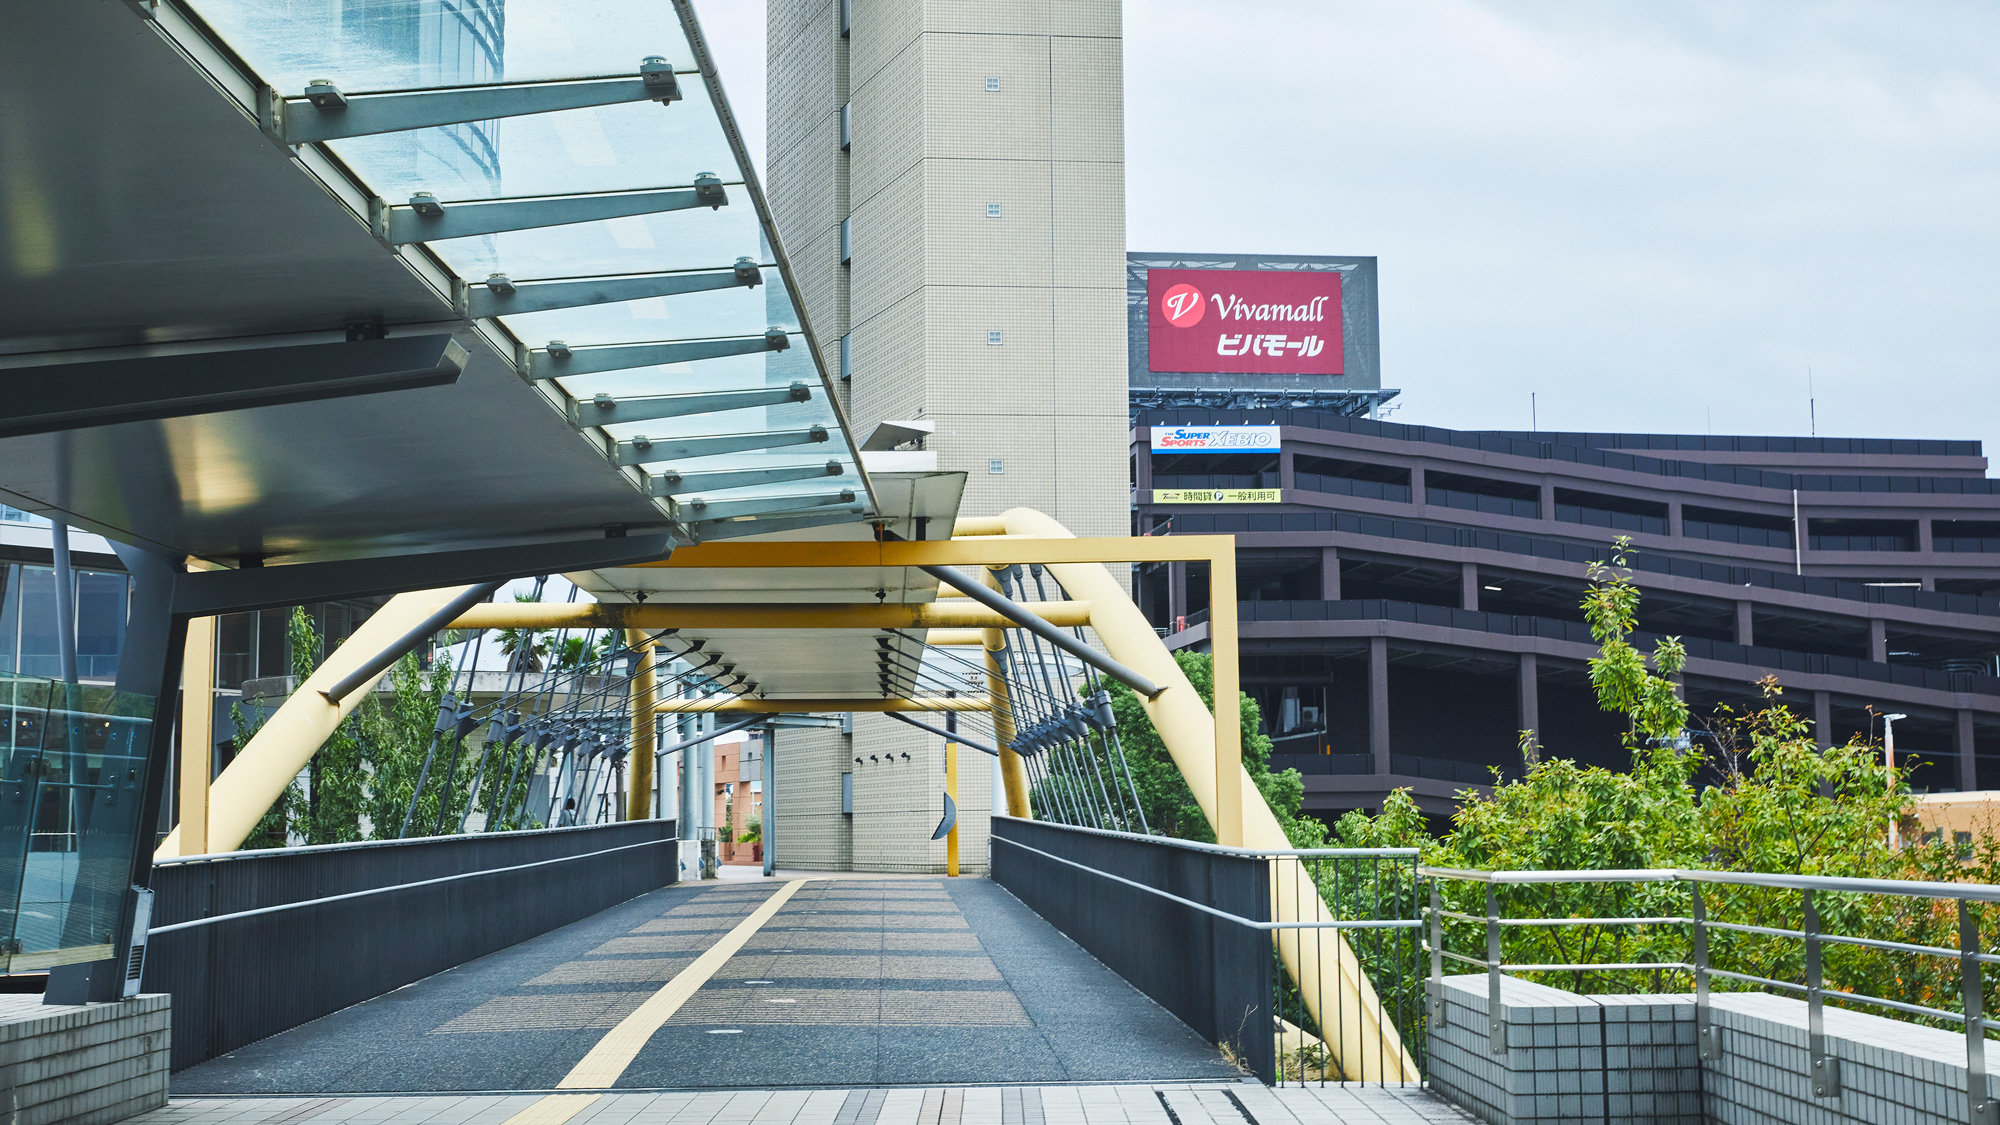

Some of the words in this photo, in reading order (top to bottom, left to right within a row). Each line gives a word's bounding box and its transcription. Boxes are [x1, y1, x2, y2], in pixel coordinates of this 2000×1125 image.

[1210, 293, 1329, 322] Vivamall
[1217, 333, 1325, 357] ビバモール
[1174, 429, 1210, 439] SUPER
[1208, 430, 1272, 447] XEBIO
[1160, 436, 1206, 447] SPORTS
[1228, 491, 1276, 501] 一般利用可
